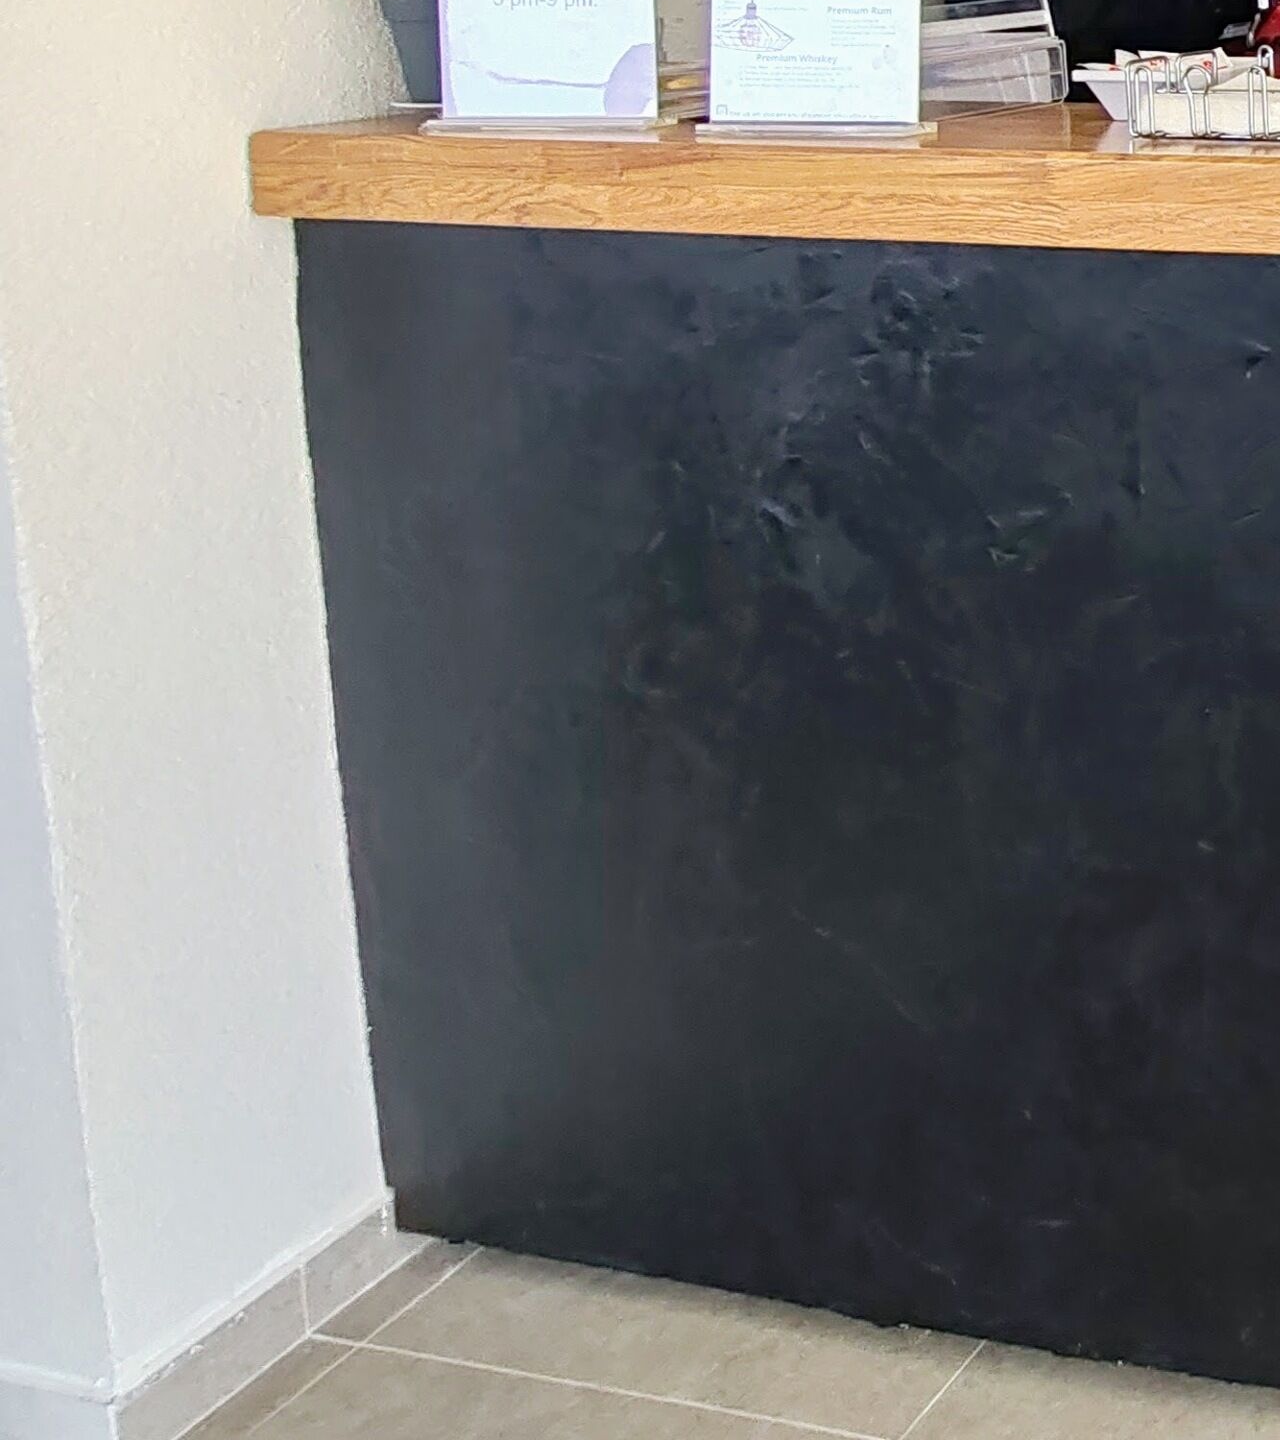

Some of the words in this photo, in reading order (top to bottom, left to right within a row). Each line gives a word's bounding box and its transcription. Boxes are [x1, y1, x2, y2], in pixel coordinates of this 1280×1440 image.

[827, 6, 868, 15] Premium
[871, 6, 892, 15] Rum
[756, 53, 797, 63] Premium
